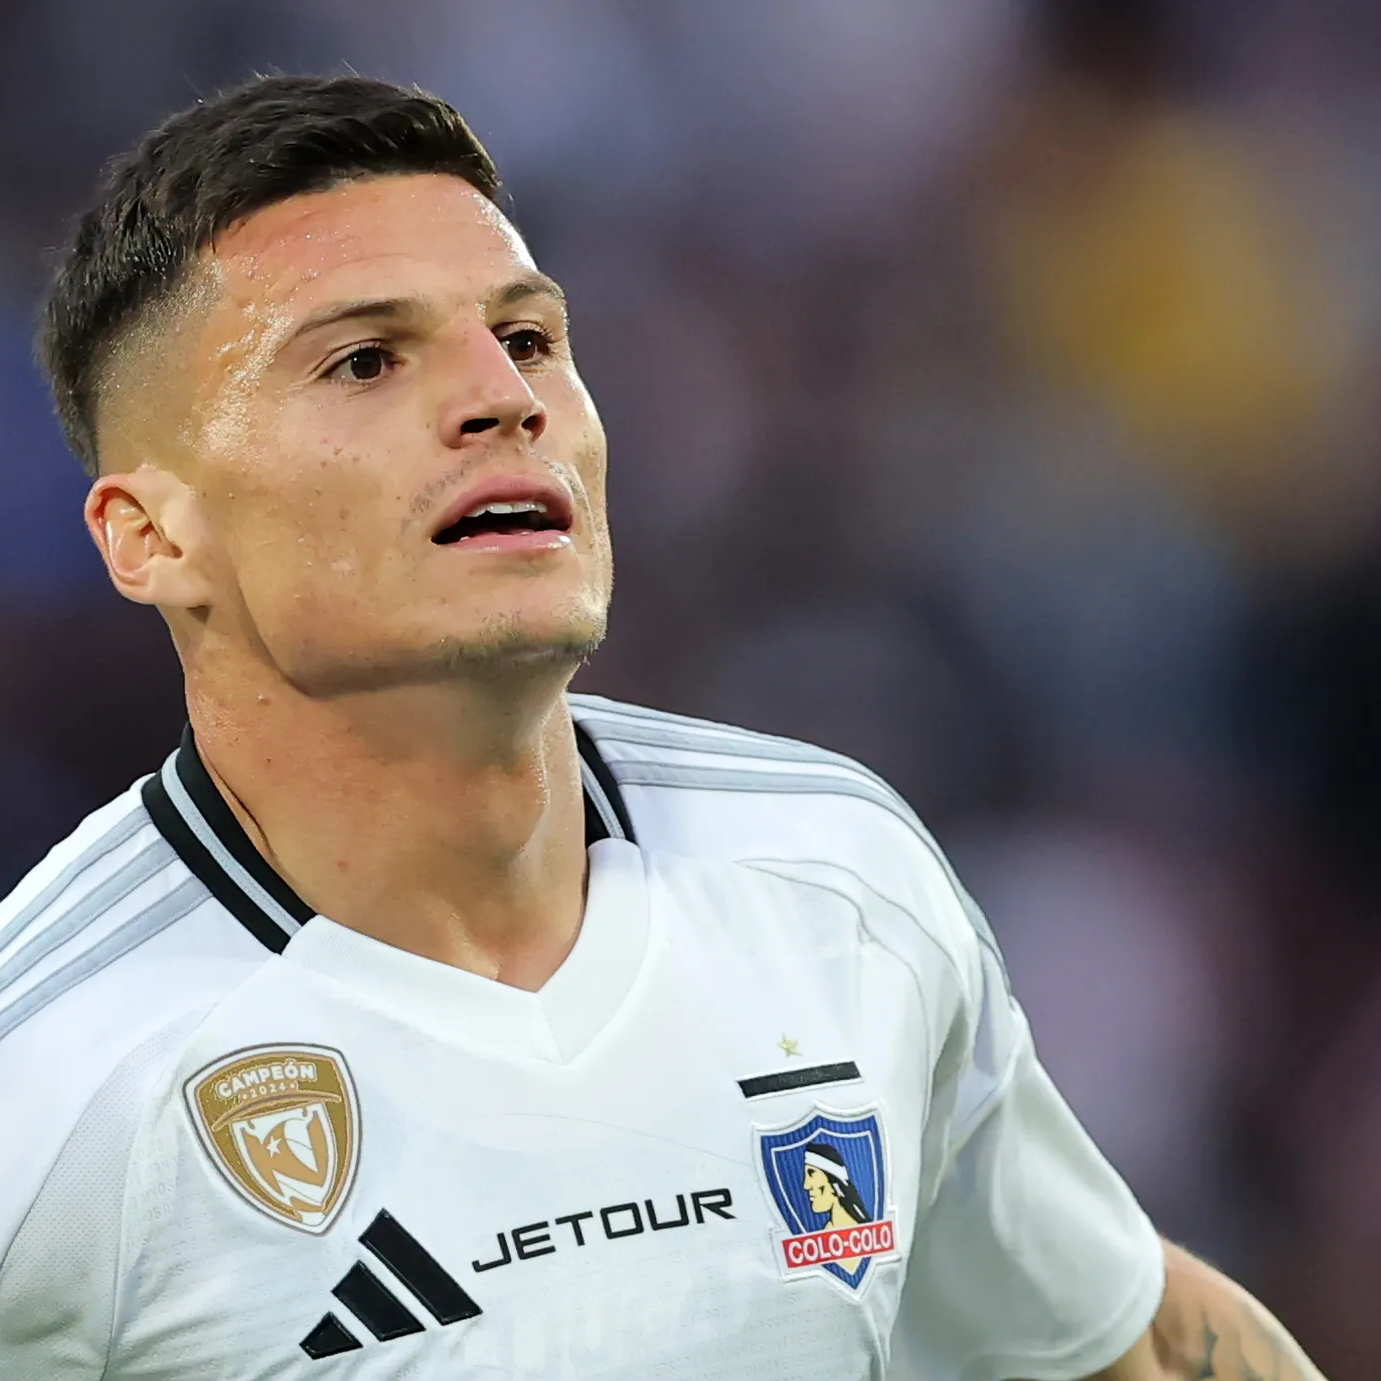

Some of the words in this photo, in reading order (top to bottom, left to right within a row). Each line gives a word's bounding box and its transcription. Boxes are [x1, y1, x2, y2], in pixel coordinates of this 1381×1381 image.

[217, 1060, 316, 1098] CAMPEÓN
[250, 1081, 288, 1099] 2024
[471, 1187, 737, 1273] JETOUR
[787, 1224, 893, 1265] COLO-COLO
